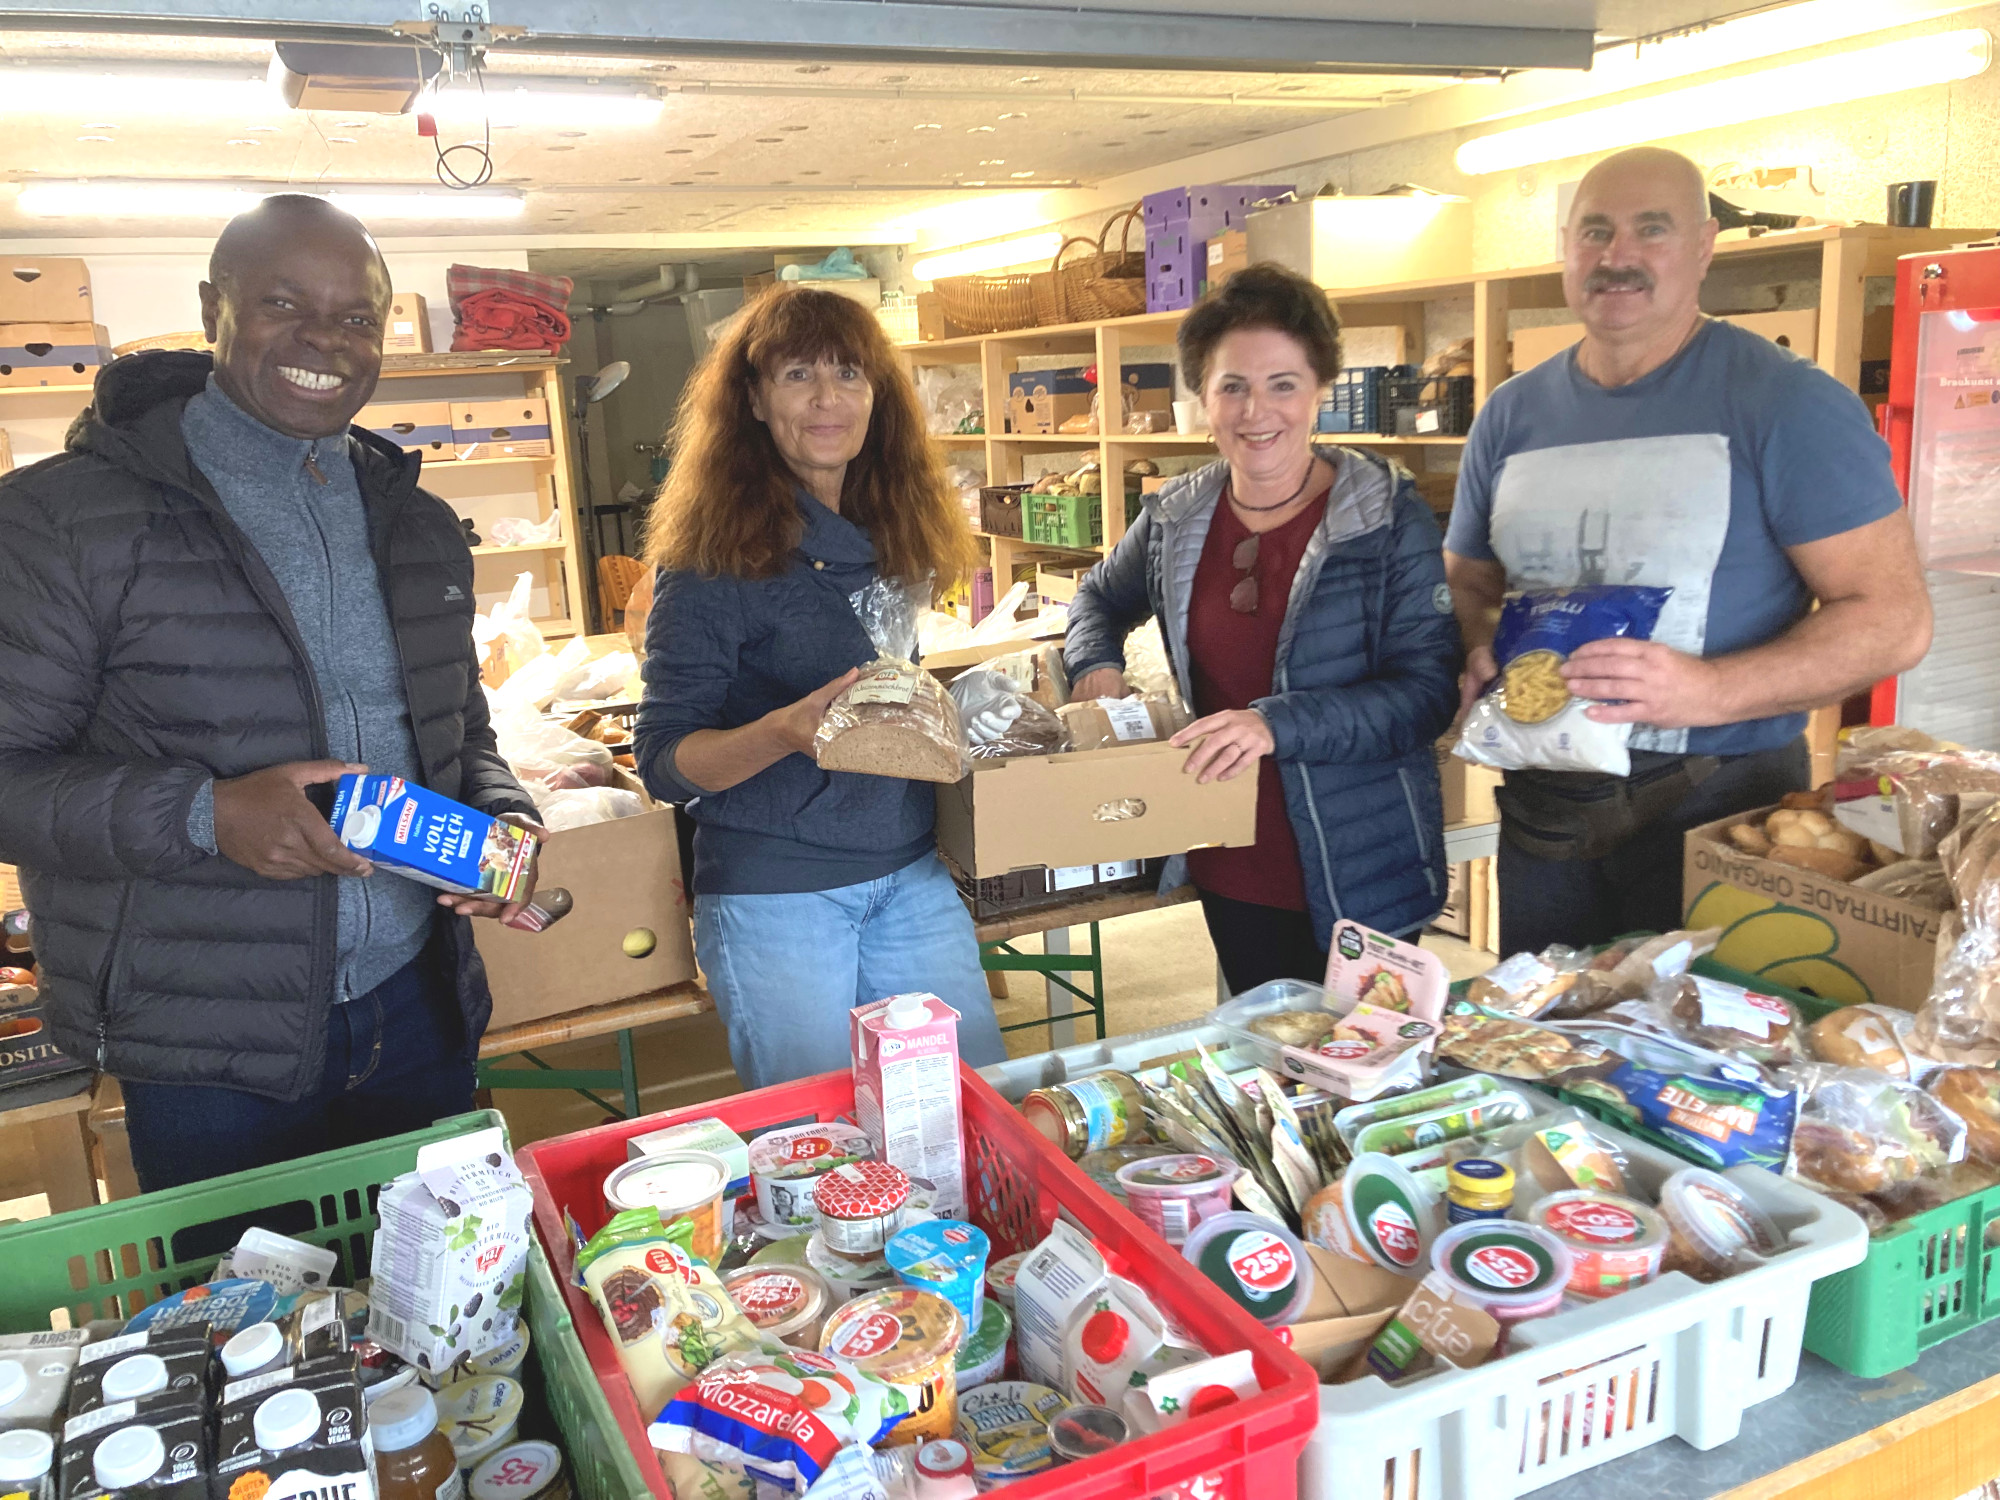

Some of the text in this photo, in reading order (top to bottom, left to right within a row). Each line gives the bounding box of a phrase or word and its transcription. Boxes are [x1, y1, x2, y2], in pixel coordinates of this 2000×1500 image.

[1940, 377, 1993, 387] Braukunst
[397, 801, 415, 841] MILSANI
[424, 813, 447, 853] VOLL
[437, 813, 464, 865] MILCH
[1695, 850, 1941, 944] FAIRTRADE ORGANIC
[906, 1033, 950, 1050] MANDEL
[461, 1163, 476, 1172] BIO
[449, 1169, 512, 1196] BUTTERMILCH
[486, 1222, 500, 1232] BIO
[1377, 1225, 1420, 1250] -25%
[460, 1232, 521, 1264] BUTTERMILCH
[650, 1251, 674, 1272] NEU
[1238, 1249, 1291, 1281] -25%
[1482, 1249, 1529, 1281] -25%
[29, 1331, 82, 1345] BARISTA
[850, 1317, 891, 1356] -50%
[488, 1343, 521, 1367] clever
[744, 1384, 793, 1407] Premium
[698, 1382, 815, 1443] Mozzarella
[327, 1433, 351, 1445] VEGAN
[328, 1425, 350, 1437] 100%
[172, 1461, 196, 1472] 100%
